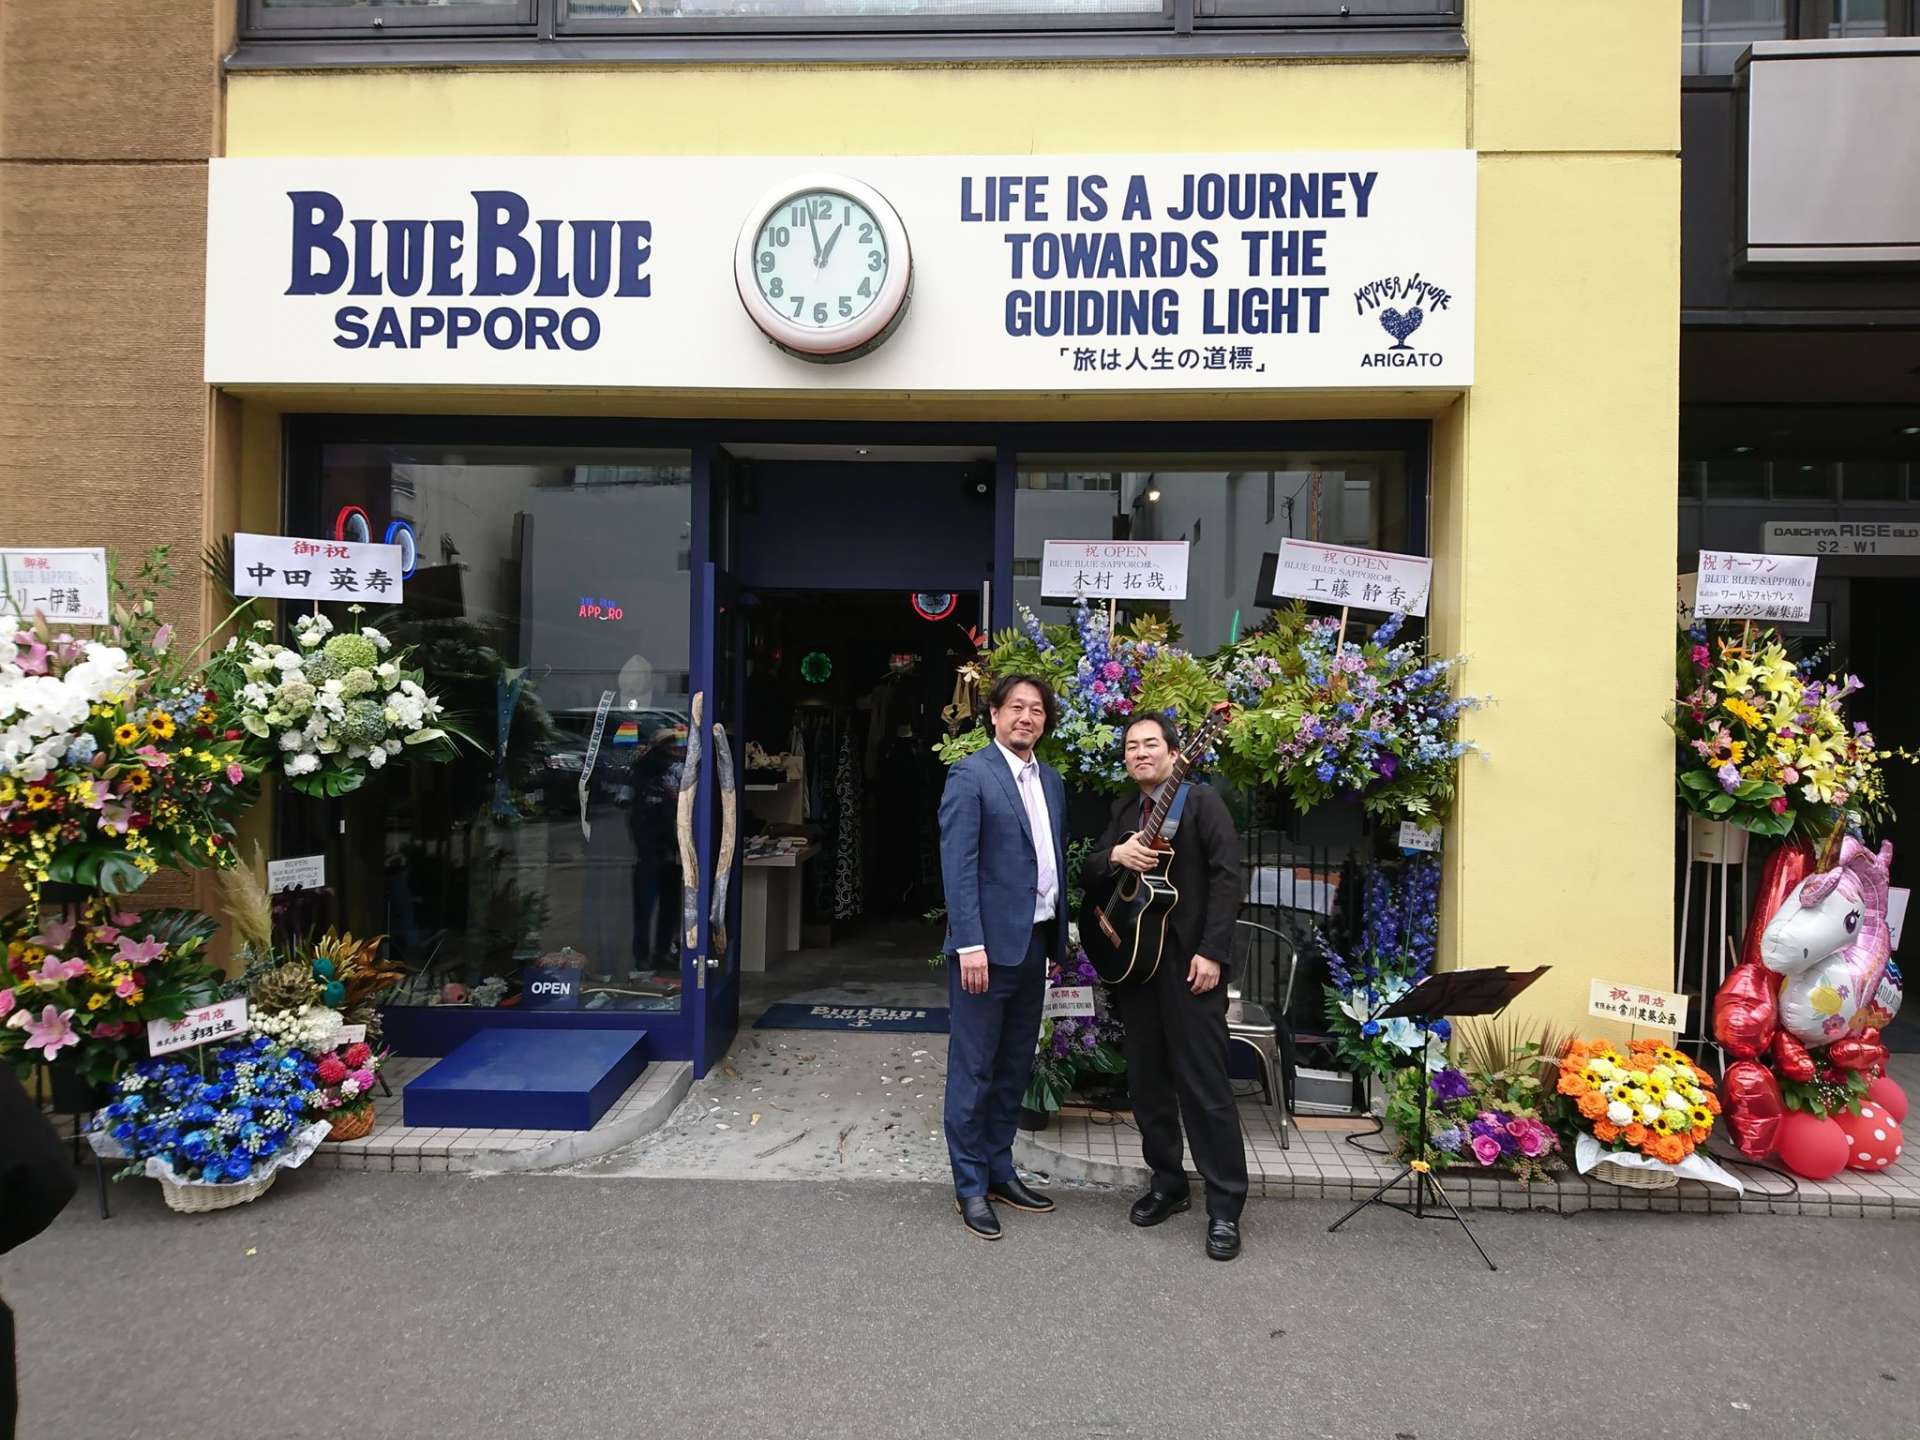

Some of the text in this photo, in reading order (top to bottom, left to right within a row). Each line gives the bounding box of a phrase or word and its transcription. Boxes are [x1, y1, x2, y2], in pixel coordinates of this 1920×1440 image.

[961, 172, 1378, 222] LIFE IS A JOURNEY
[792, 207, 806, 227] 11
[811, 200, 832, 220] 12
[844, 206, 850, 226] 1
[769, 226, 790, 248] 10
[858, 223, 873, 243] 2
[760, 251, 775, 273] 9
[868, 250, 882, 272] 3
[1004, 230, 1327, 279] TOWARDS THE
[769, 277, 784, 298] 8
[857, 277, 871, 298] 4
[1354, 272, 1452, 315] MOTHER NATURE
[790, 296, 805, 317] 7
[813, 302, 828, 323] 6
[838, 296, 853, 317] 5
[1005, 287, 1330, 337] GUIDING LIGHT
[333, 306, 601, 351] SAPPORO
[1060, 346, 1266, 373] 「旅は人生の道標」
[1361, 353, 1443, 367] ARIGATO
[1839, 525, 1891, 537] RISE
[293, 541, 351, 560] 御祝
[1086, 545, 1147, 558] 祝 OPEN
[1323, 551, 1390, 570] 祝 OPEN
[1049, 560, 1072, 569] BLUE
[1075, 560, 1098, 569] BLUE
[1284, 561, 1309, 571] BLUE
[1311, 565, 1337, 575] BLUE
[1703, 554, 1779, 572] 祝 オープン
[246, 562, 393, 594] 中田 英寿
[1072, 570, 1114, 590] 木村
[1122, 571, 1165, 591] 拓哉
[1705, 574, 1730, 584] BLUE
[1732, 576, 1758, 586] BLUE
[1760, 577, 1805, 587] SAPPORO
[1307, 578, 1351, 599] 工藤
[1362, 583, 1406, 607] 静香
[531, 982, 570, 994] OPEN
[1609, 987, 1666, 1008] 祝 開店
[198, 1007, 225, 1022] 開店
